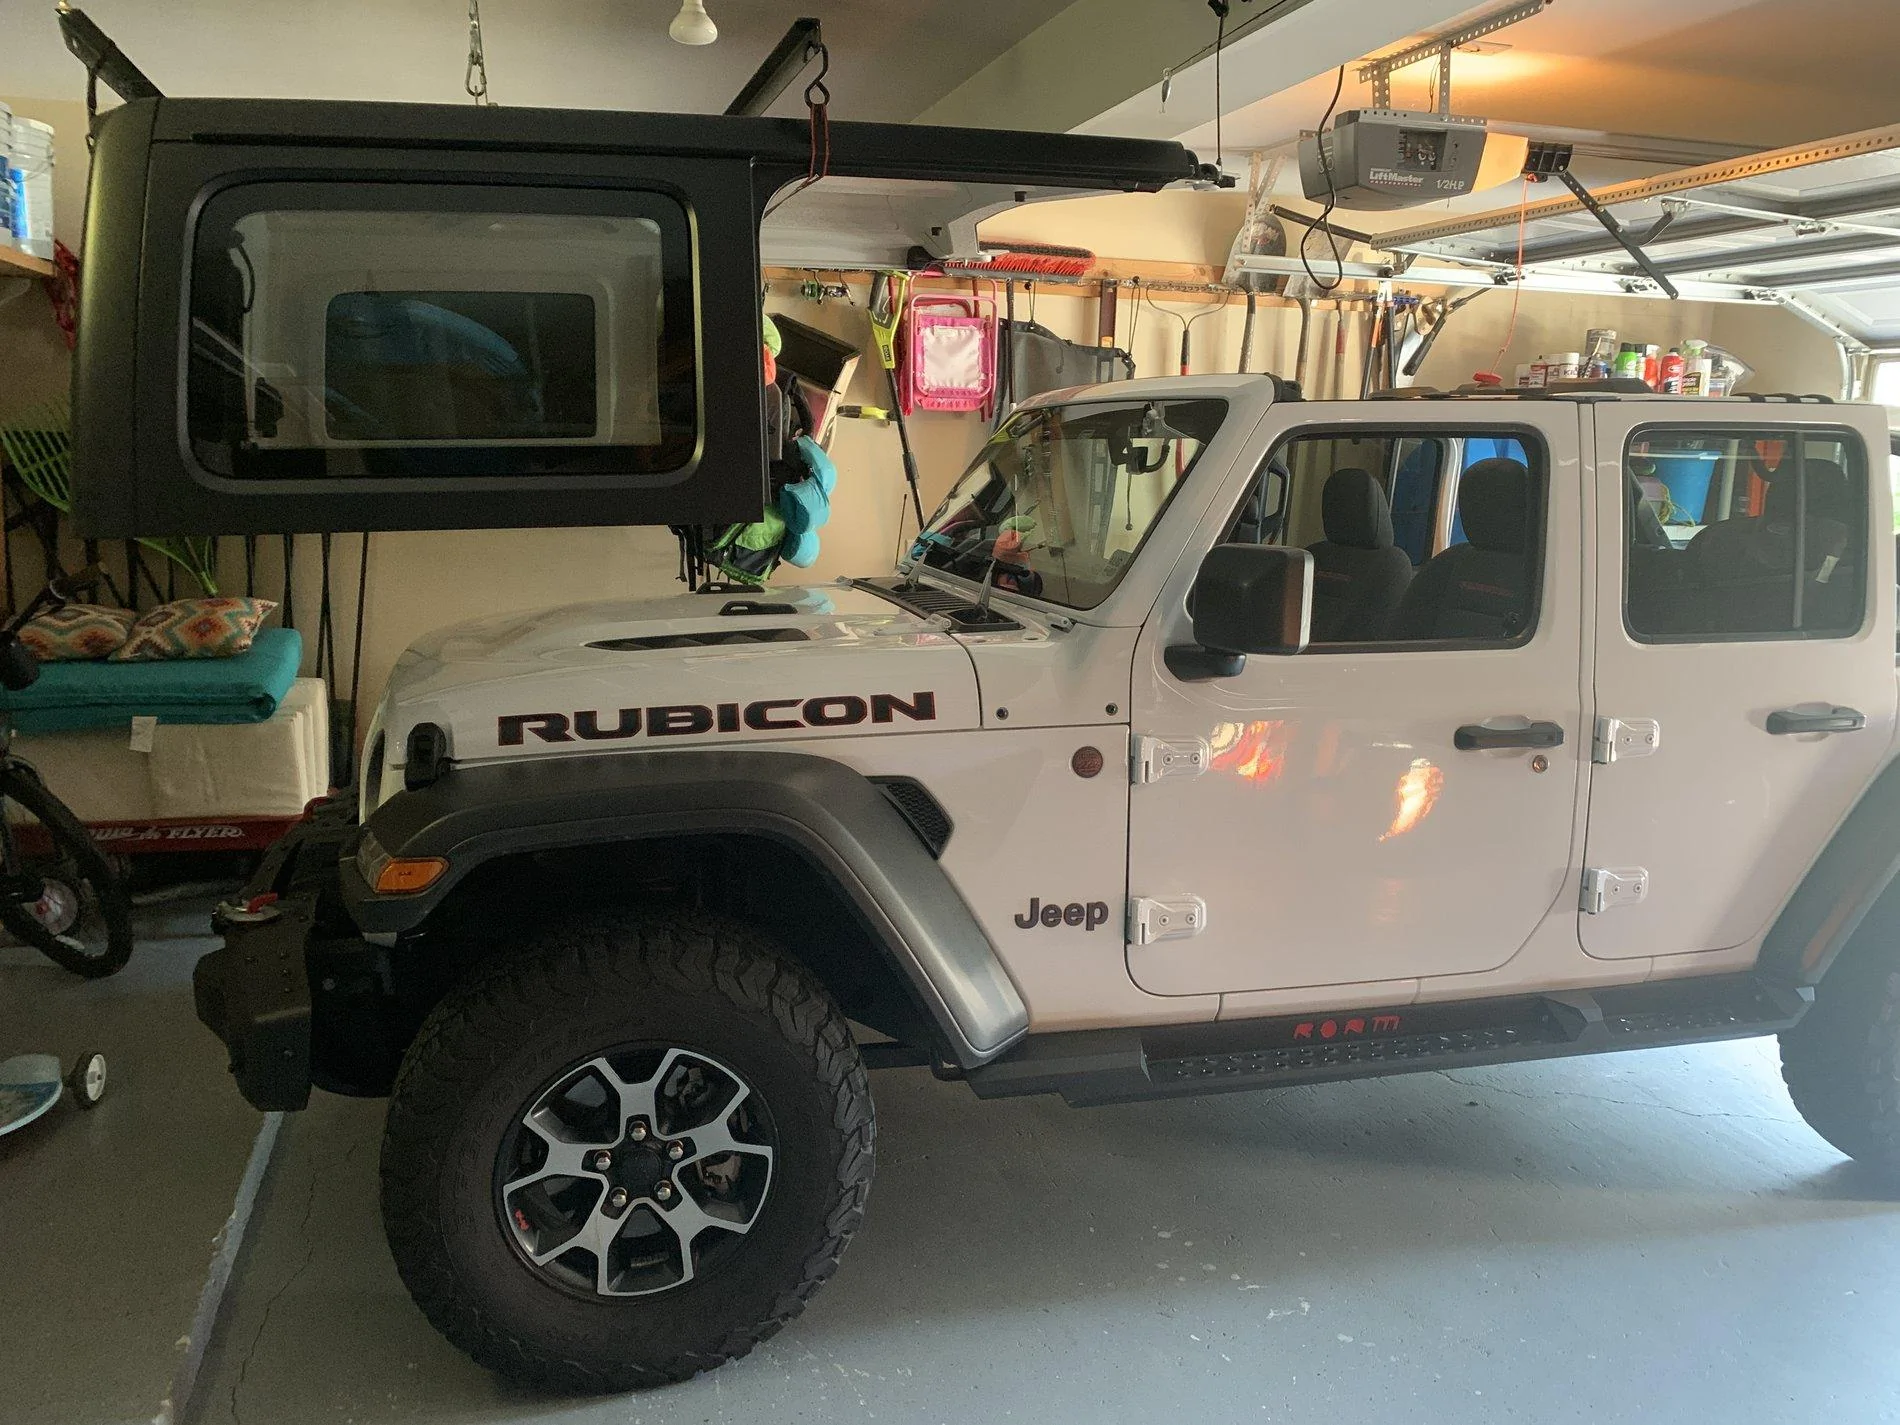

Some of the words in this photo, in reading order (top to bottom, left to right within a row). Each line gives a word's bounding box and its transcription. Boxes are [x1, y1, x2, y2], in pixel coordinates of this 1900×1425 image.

[1369, 170, 1424, 183] LiftMaster
[498, 691, 936, 746] RUBICON
[166, 824, 243, 839] FLYER
[1014, 897, 1108, 931] Jeep
